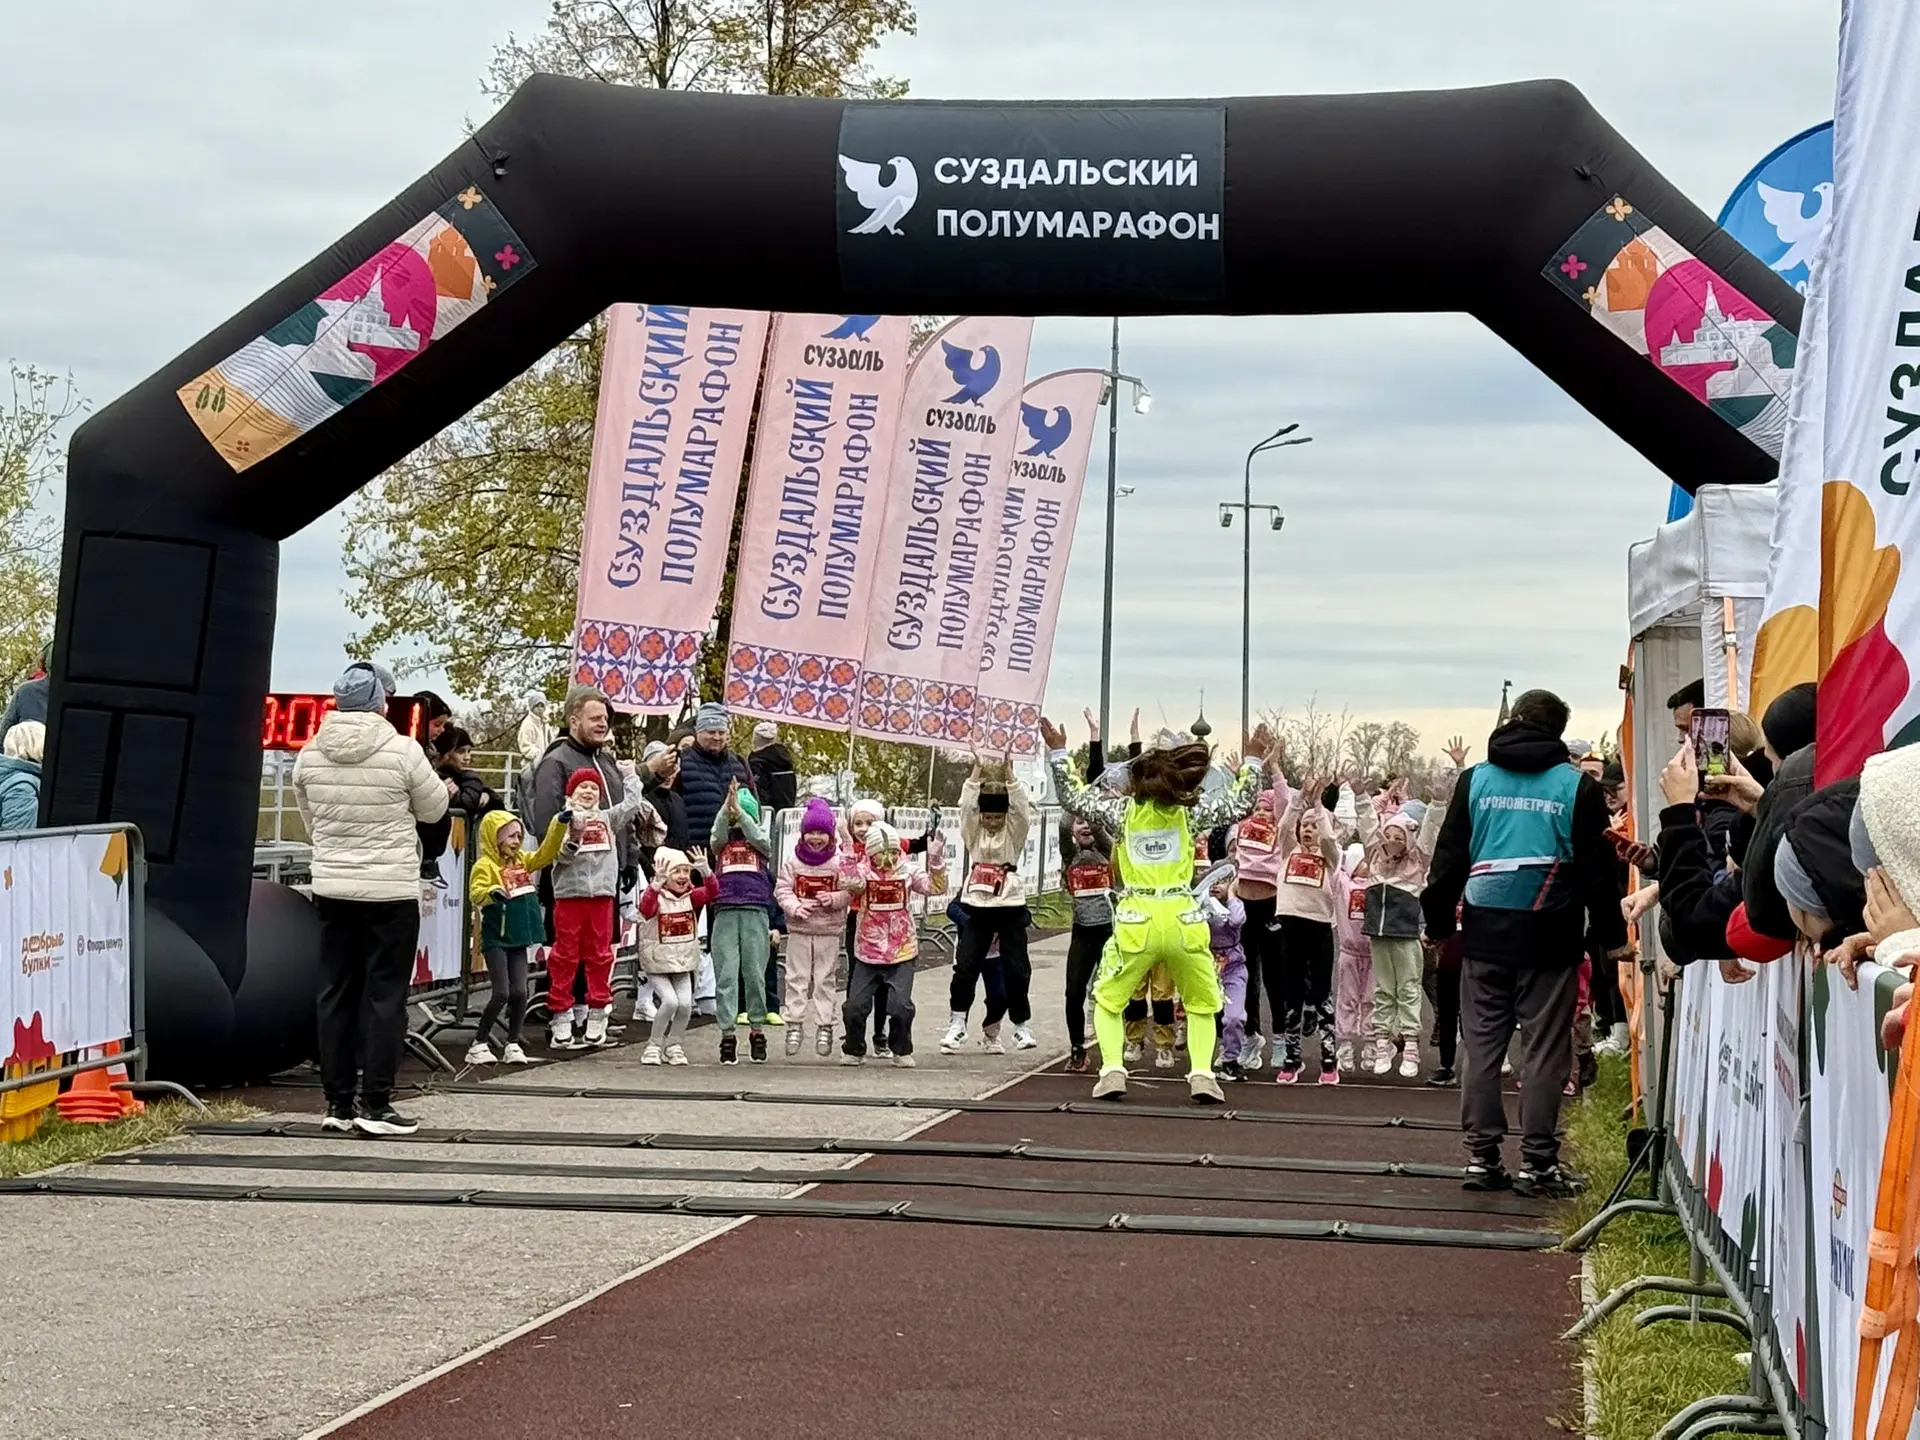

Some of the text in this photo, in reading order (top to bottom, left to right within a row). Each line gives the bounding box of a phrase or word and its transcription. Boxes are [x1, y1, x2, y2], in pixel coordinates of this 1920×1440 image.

[934, 153, 1198, 189] СУЗДАЛЬСКИЙ
[937, 208, 1220, 241] ПОЛУМАРАФОН
[607, 305, 694, 589] СУЗДАЛЬСКИЙ
[660, 321, 744, 585] ПОЛУМАРАФОН
[760, 377, 837, 620] СУЗДАЛЬСКИЙ
[817, 393, 879, 620] ПОЛУМАРАФОН
[887, 437, 954, 652] СУЗДАЛЬСКИЙ
[937, 452, 991, 651] ПОЛУМАРАФОН
[1007, 498, 1061, 675] ПОЛУМАРАФОН
[1479, 796, 1566, 817] ХРОНОМЕТРИСТ
